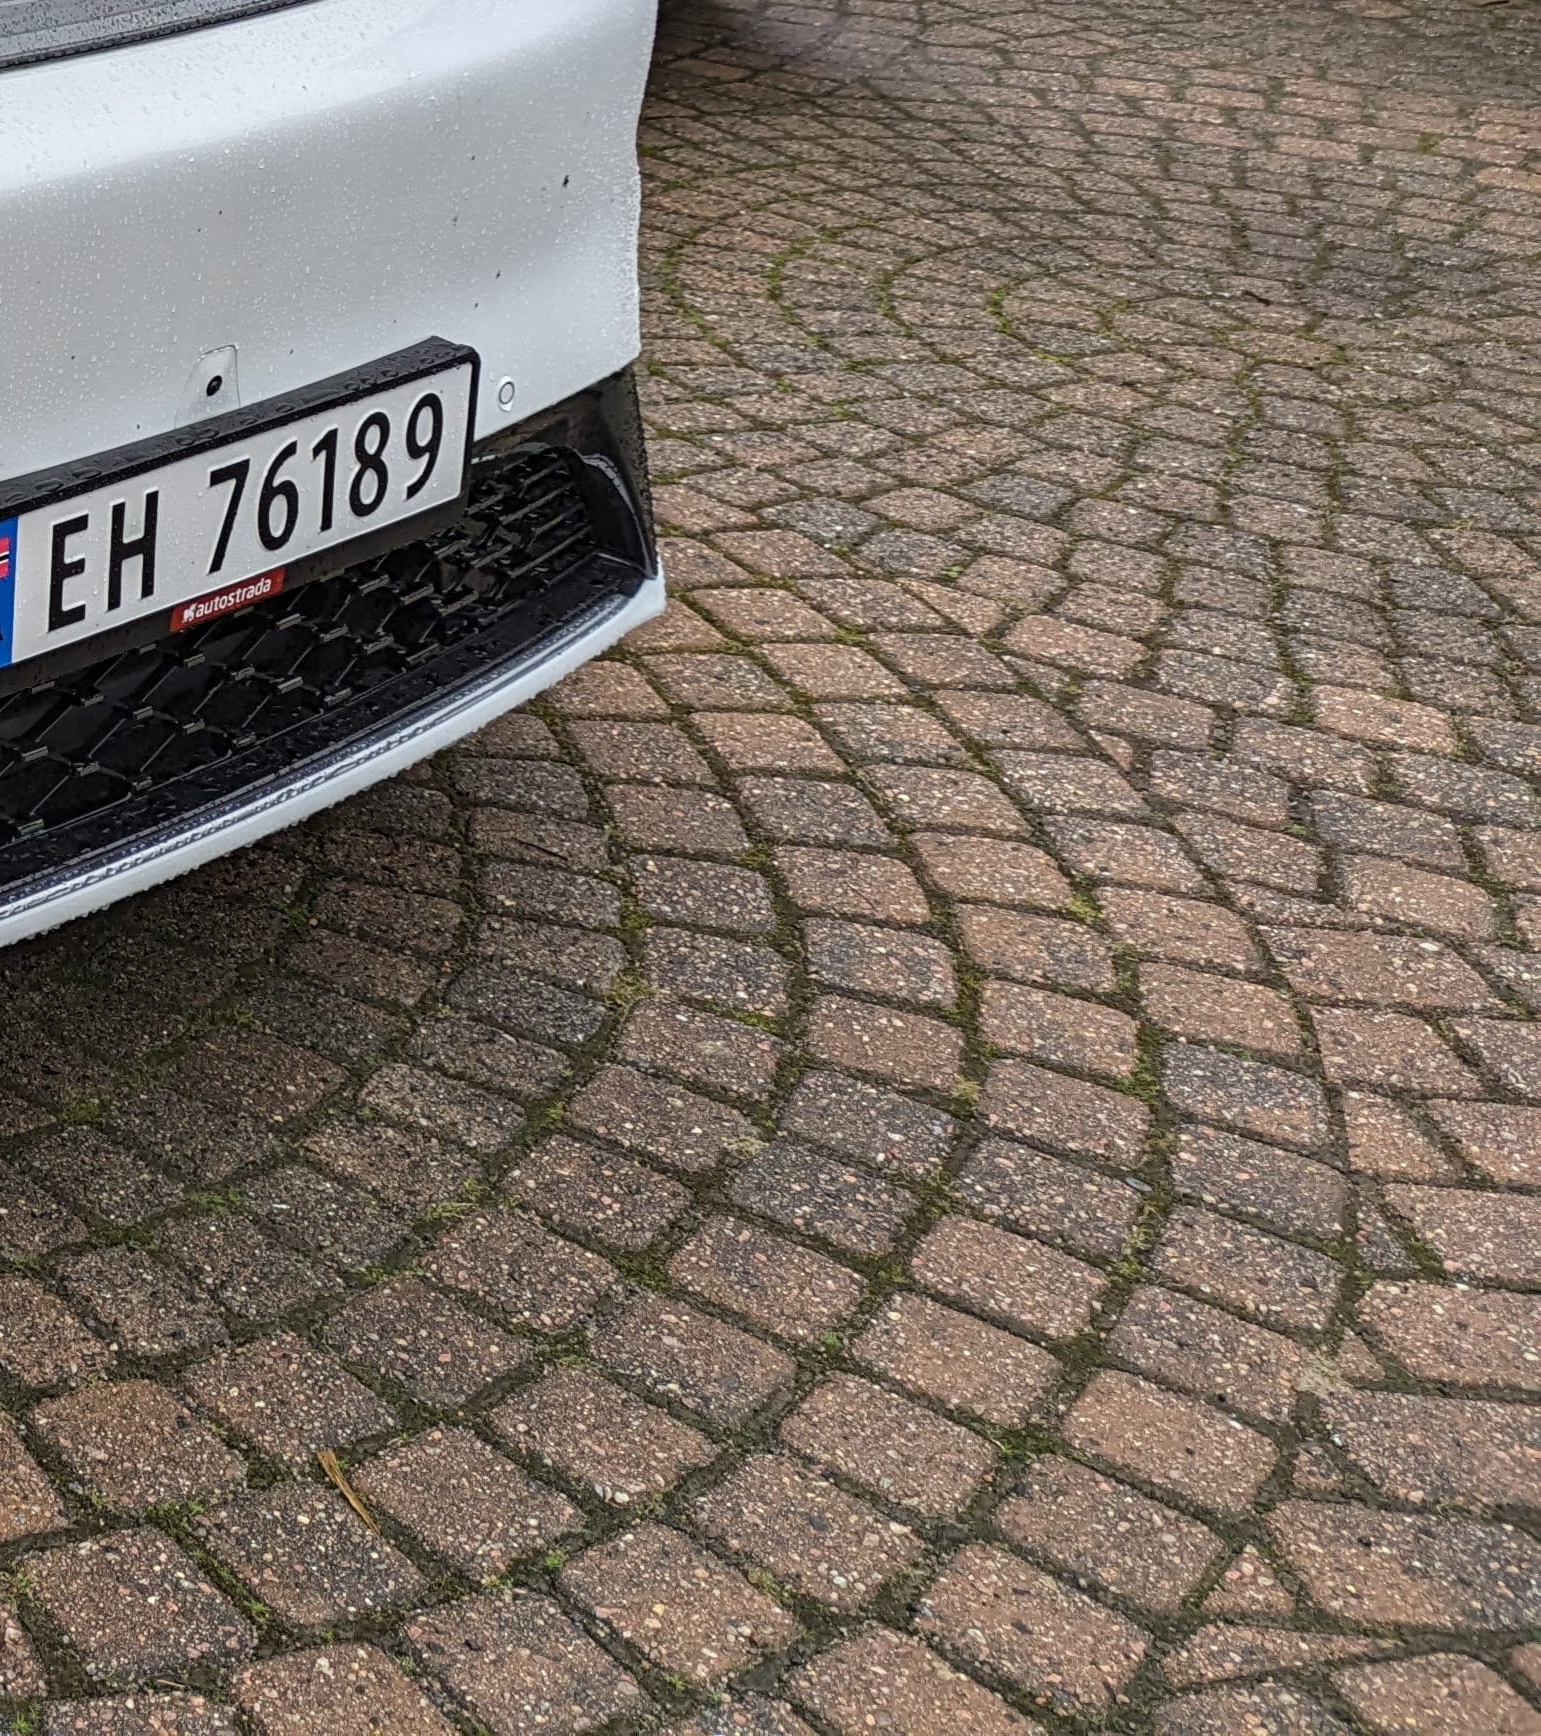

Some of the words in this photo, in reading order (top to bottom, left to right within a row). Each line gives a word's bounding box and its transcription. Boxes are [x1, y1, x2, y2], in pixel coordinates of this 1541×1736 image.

[48, 490, 159, 633] EH
[208, 392, 443, 575] 76189
[195, 577, 272, 618] autostrada
